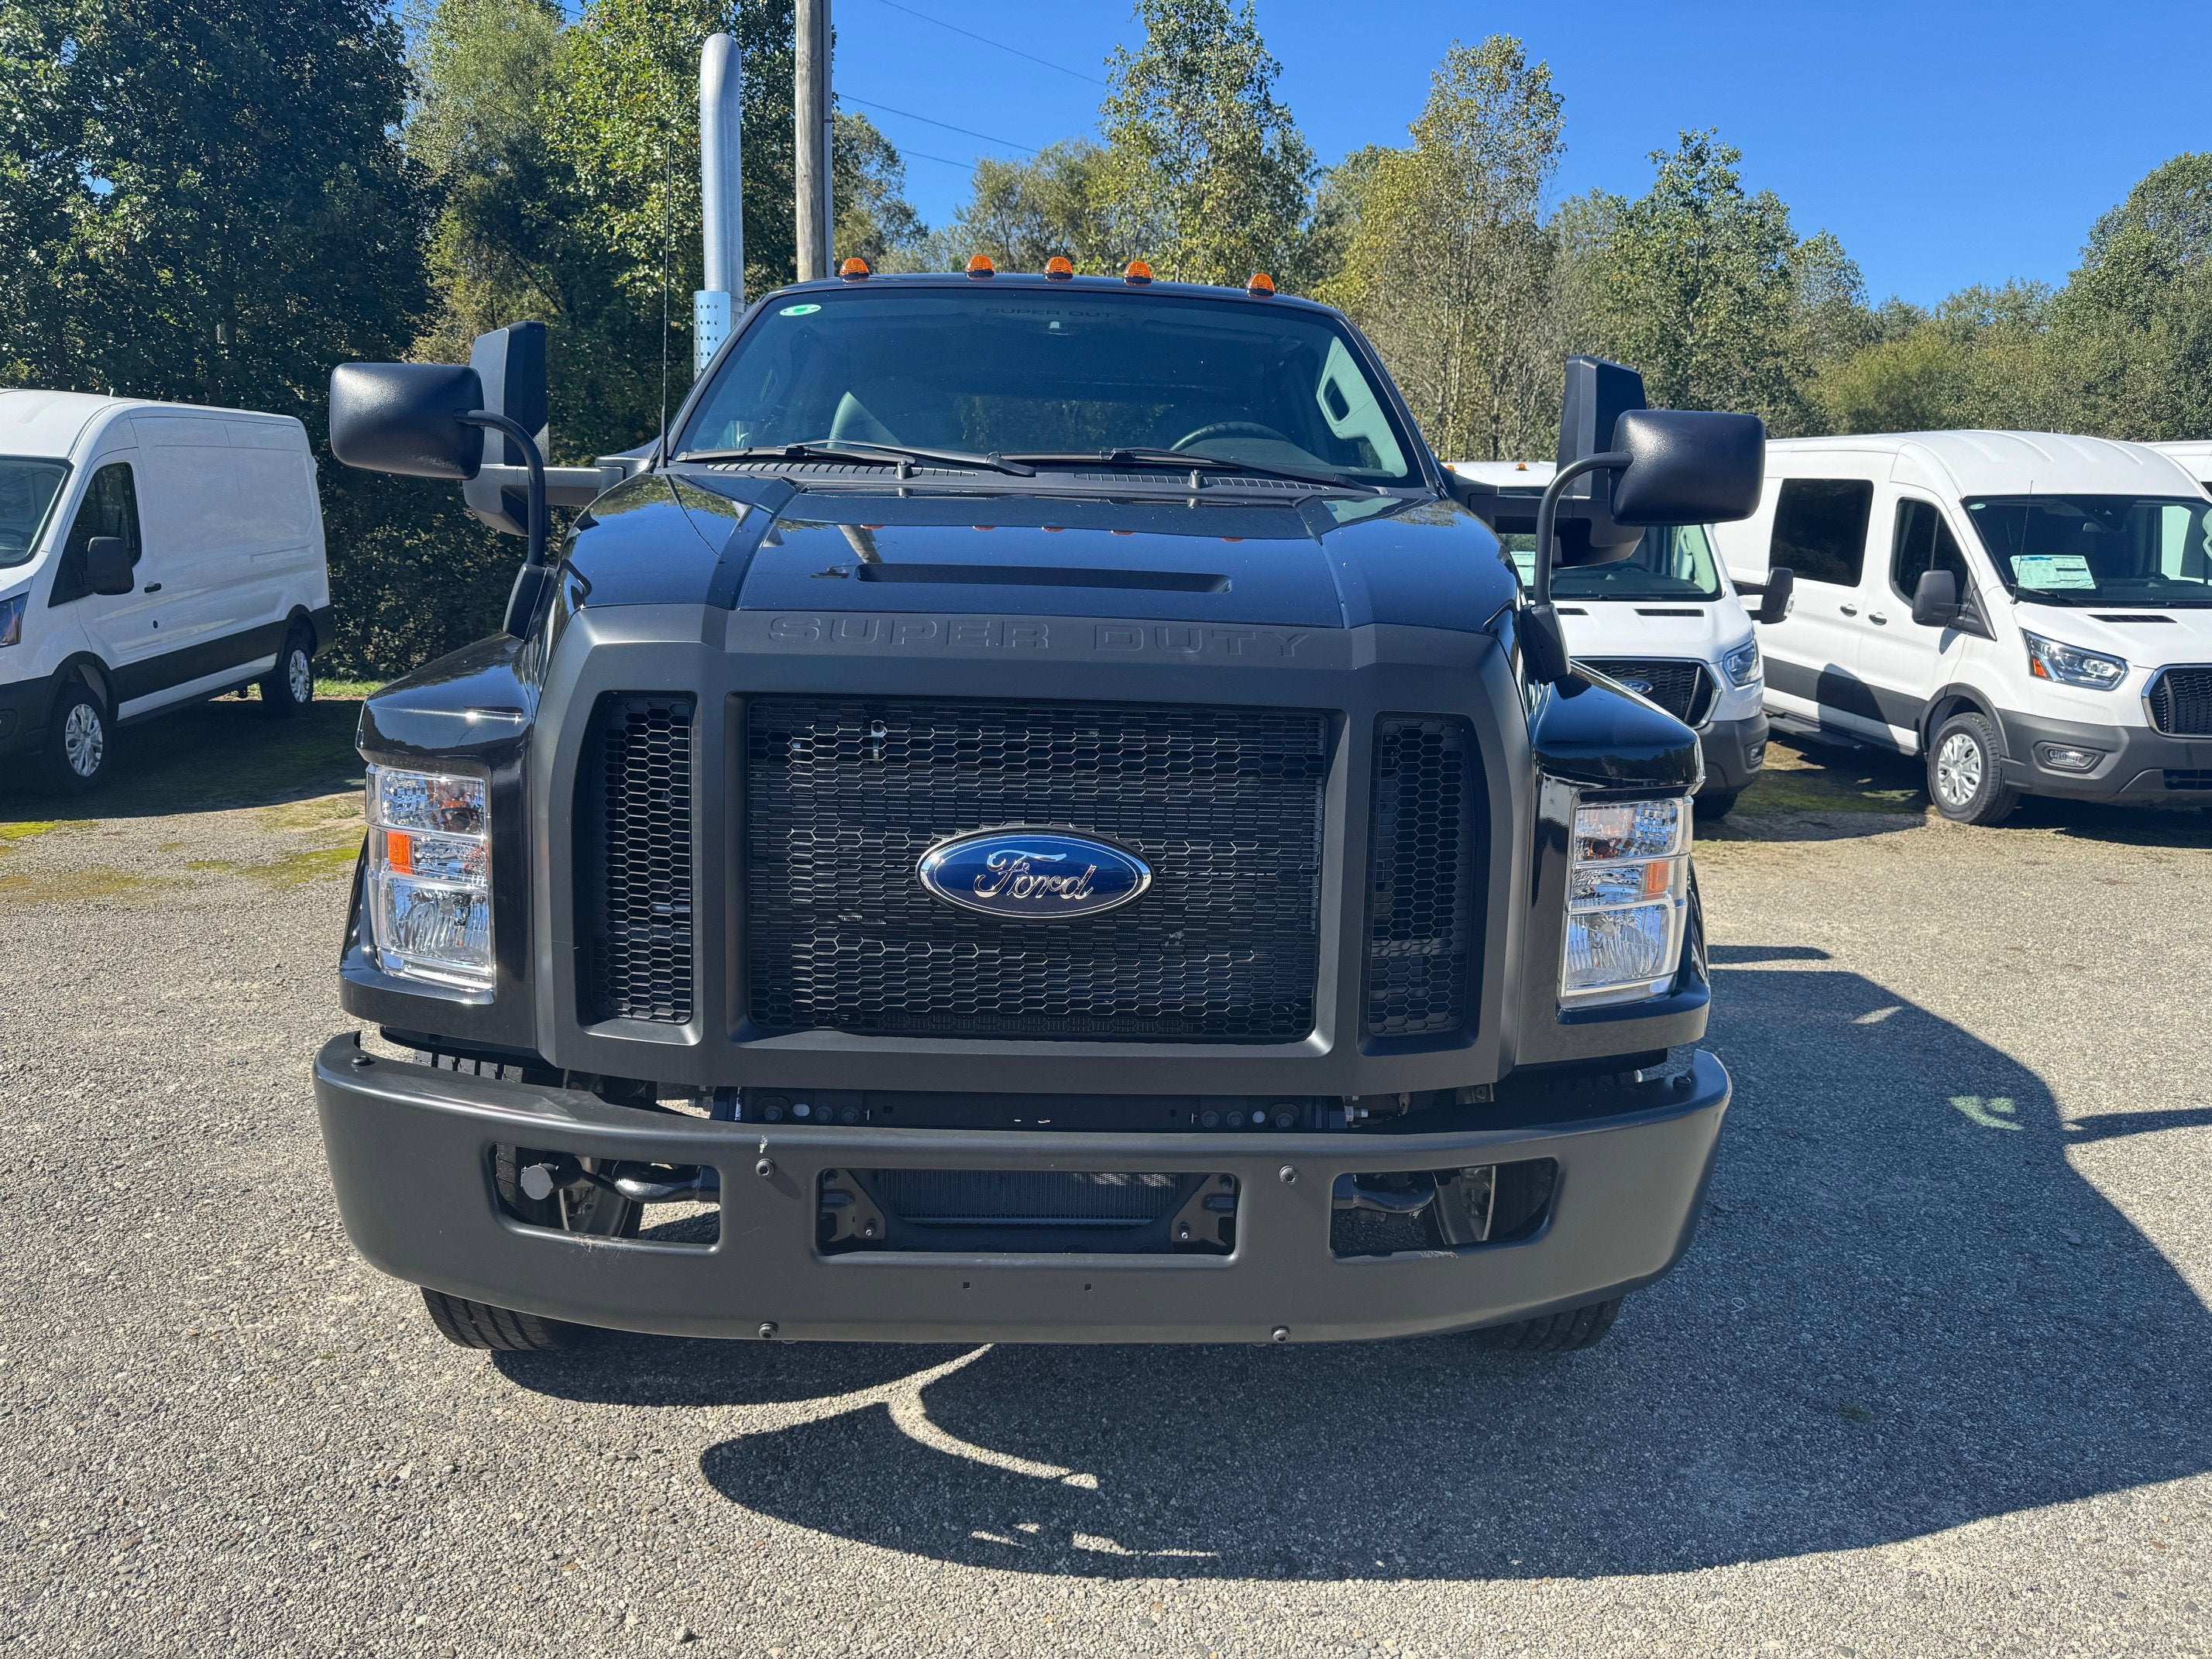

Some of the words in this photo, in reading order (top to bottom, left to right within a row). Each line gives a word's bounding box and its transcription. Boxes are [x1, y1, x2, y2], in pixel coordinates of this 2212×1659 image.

[984, 307, 1060, 316] SUPER
[768, 617, 1049, 649] SUPER
[1094, 624, 1310, 658] DUTY
[973, 849, 1097, 900] Ford
